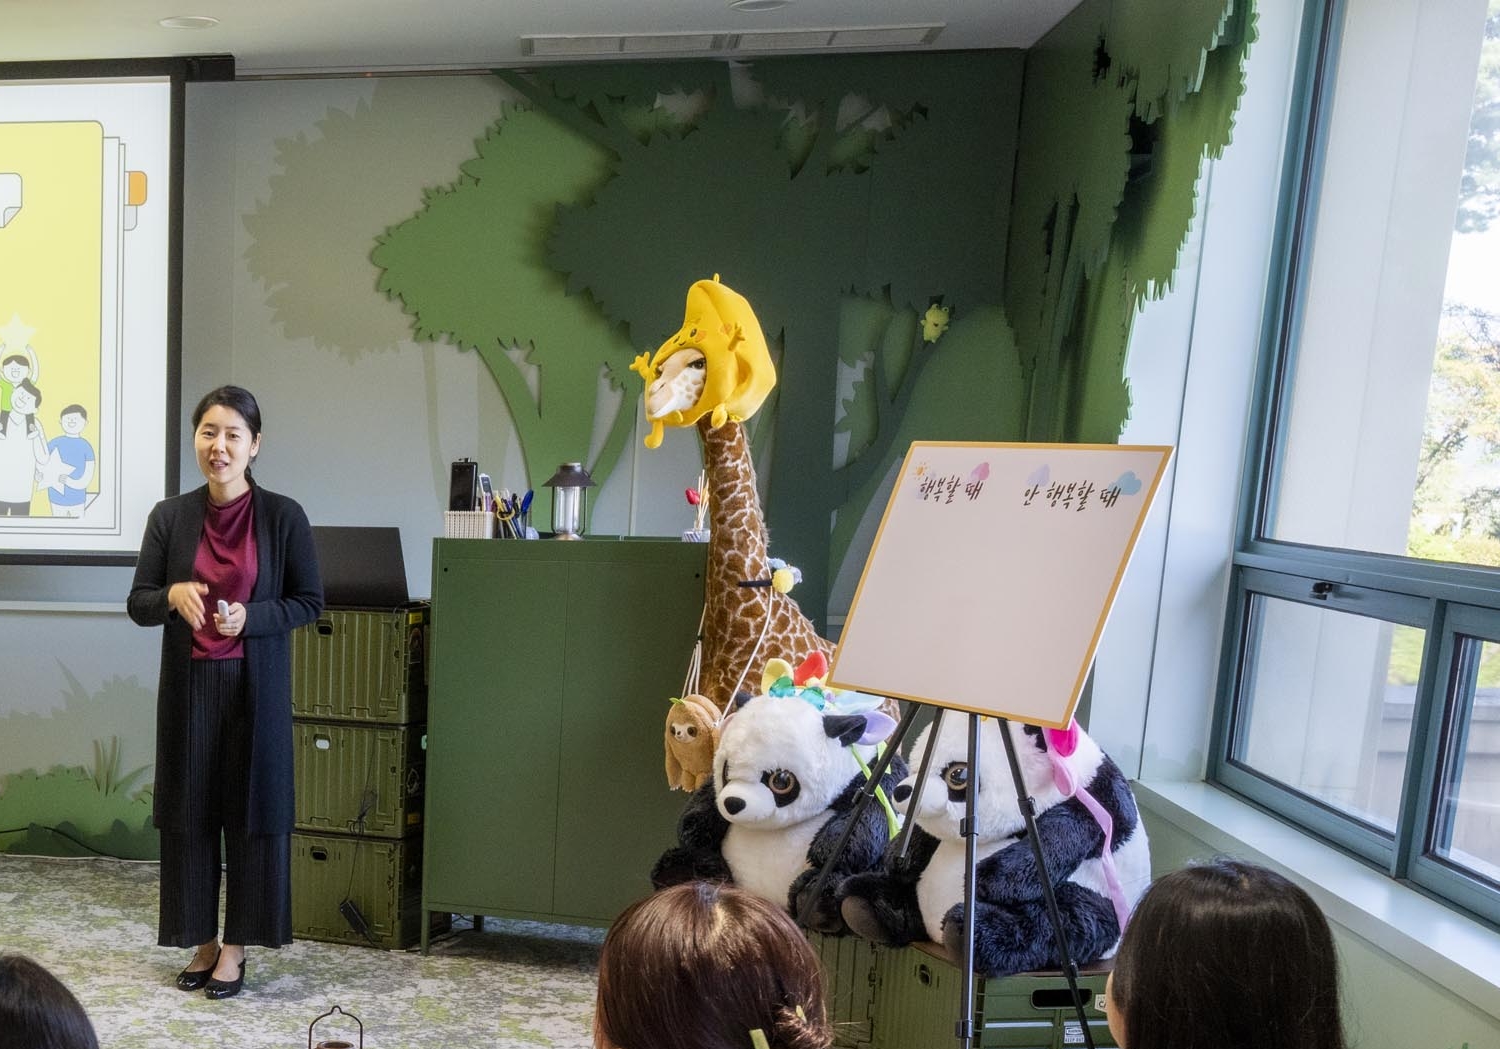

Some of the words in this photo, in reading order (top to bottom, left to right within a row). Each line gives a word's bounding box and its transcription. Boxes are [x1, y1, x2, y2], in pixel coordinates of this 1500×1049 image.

[920, 475, 961, 504] 행복할
[965, 480, 984, 501] 때
[1024, 484, 1040, 506] 안
[1046, 479, 1096, 512] 행복할
[1100, 485, 1122, 508] 때
